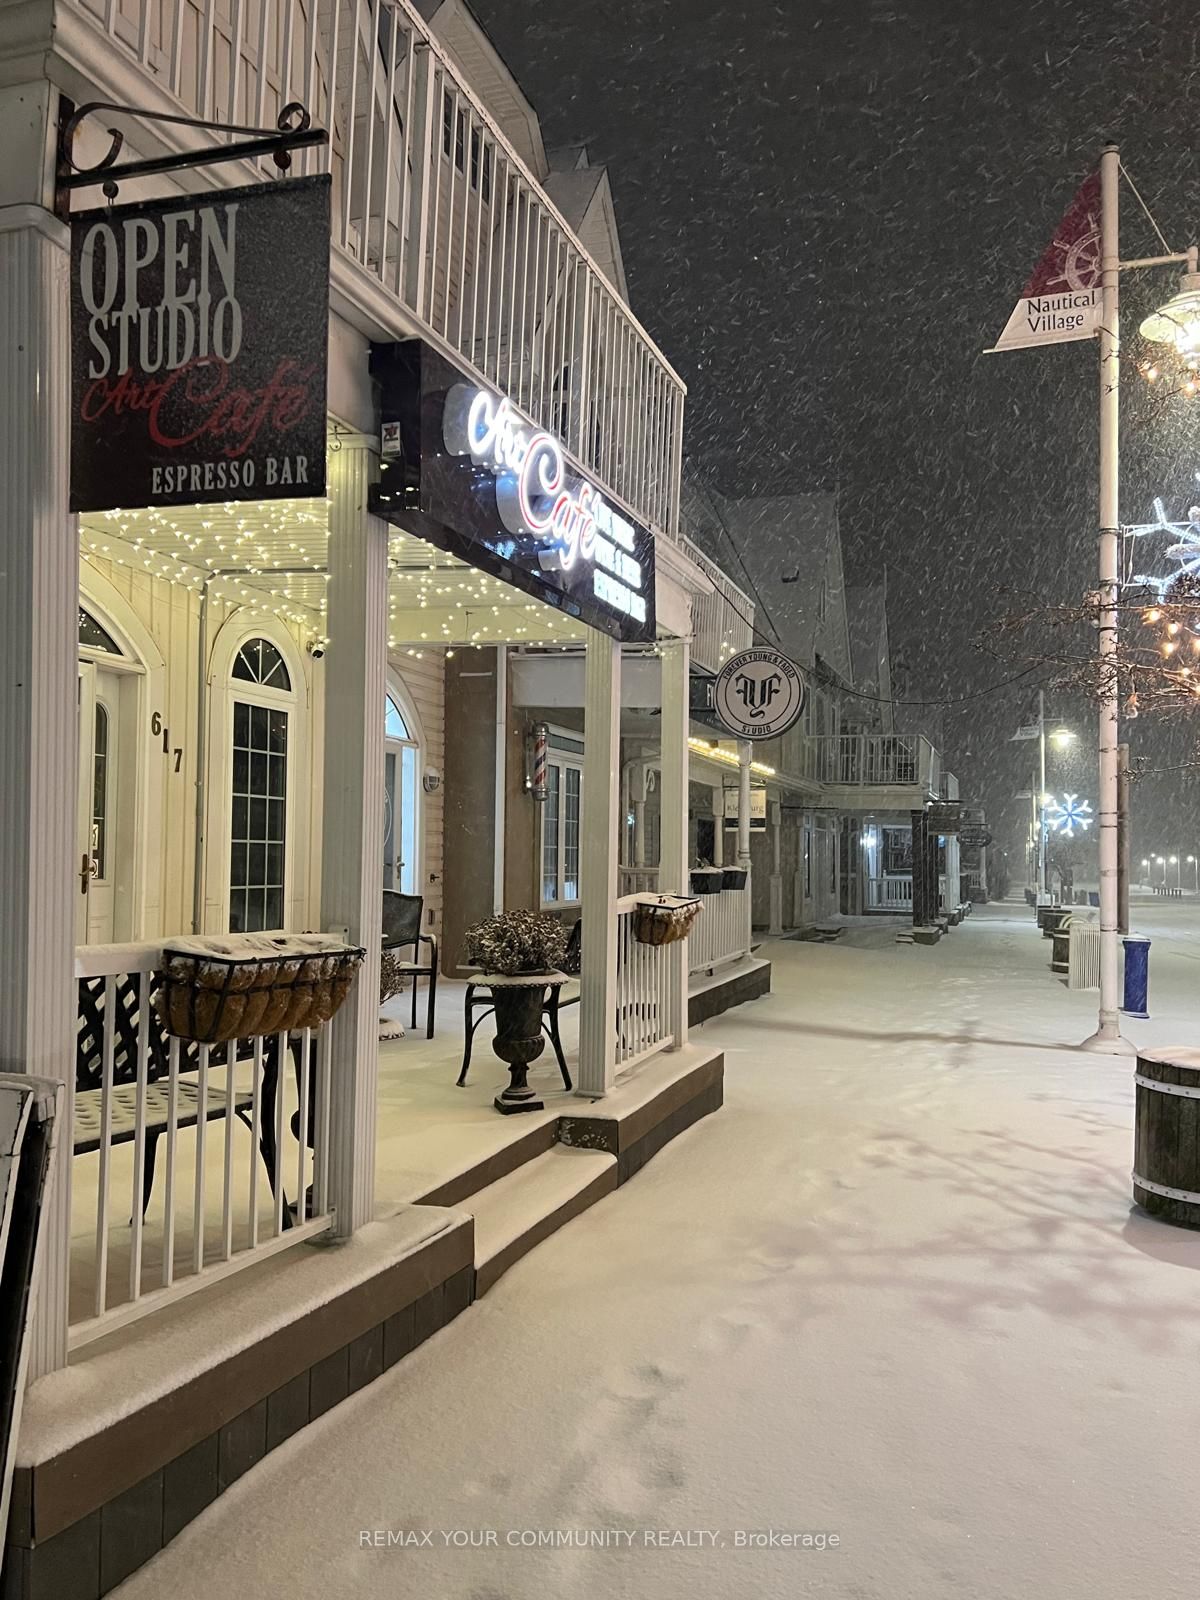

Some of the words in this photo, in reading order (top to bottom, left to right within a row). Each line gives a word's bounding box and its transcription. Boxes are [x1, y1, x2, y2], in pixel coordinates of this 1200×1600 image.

[80, 204, 239, 313] OPEN
[1028, 291, 1096, 315] Nautical
[88, 296, 243, 380] STUDIO
[1028, 314, 1084, 333] Village
[151, 459, 255, 496] ESPRESSO
[265, 455, 309, 486] BAR
[723, 657, 747, 680] FOREVER
[749, 653, 773, 661] YOUNG
[772, 655, 779, 663] &
[778, 661, 796, 679] FADED
[151, 711, 183, 773] 617
[741, 725, 772, 735] STUDIO
